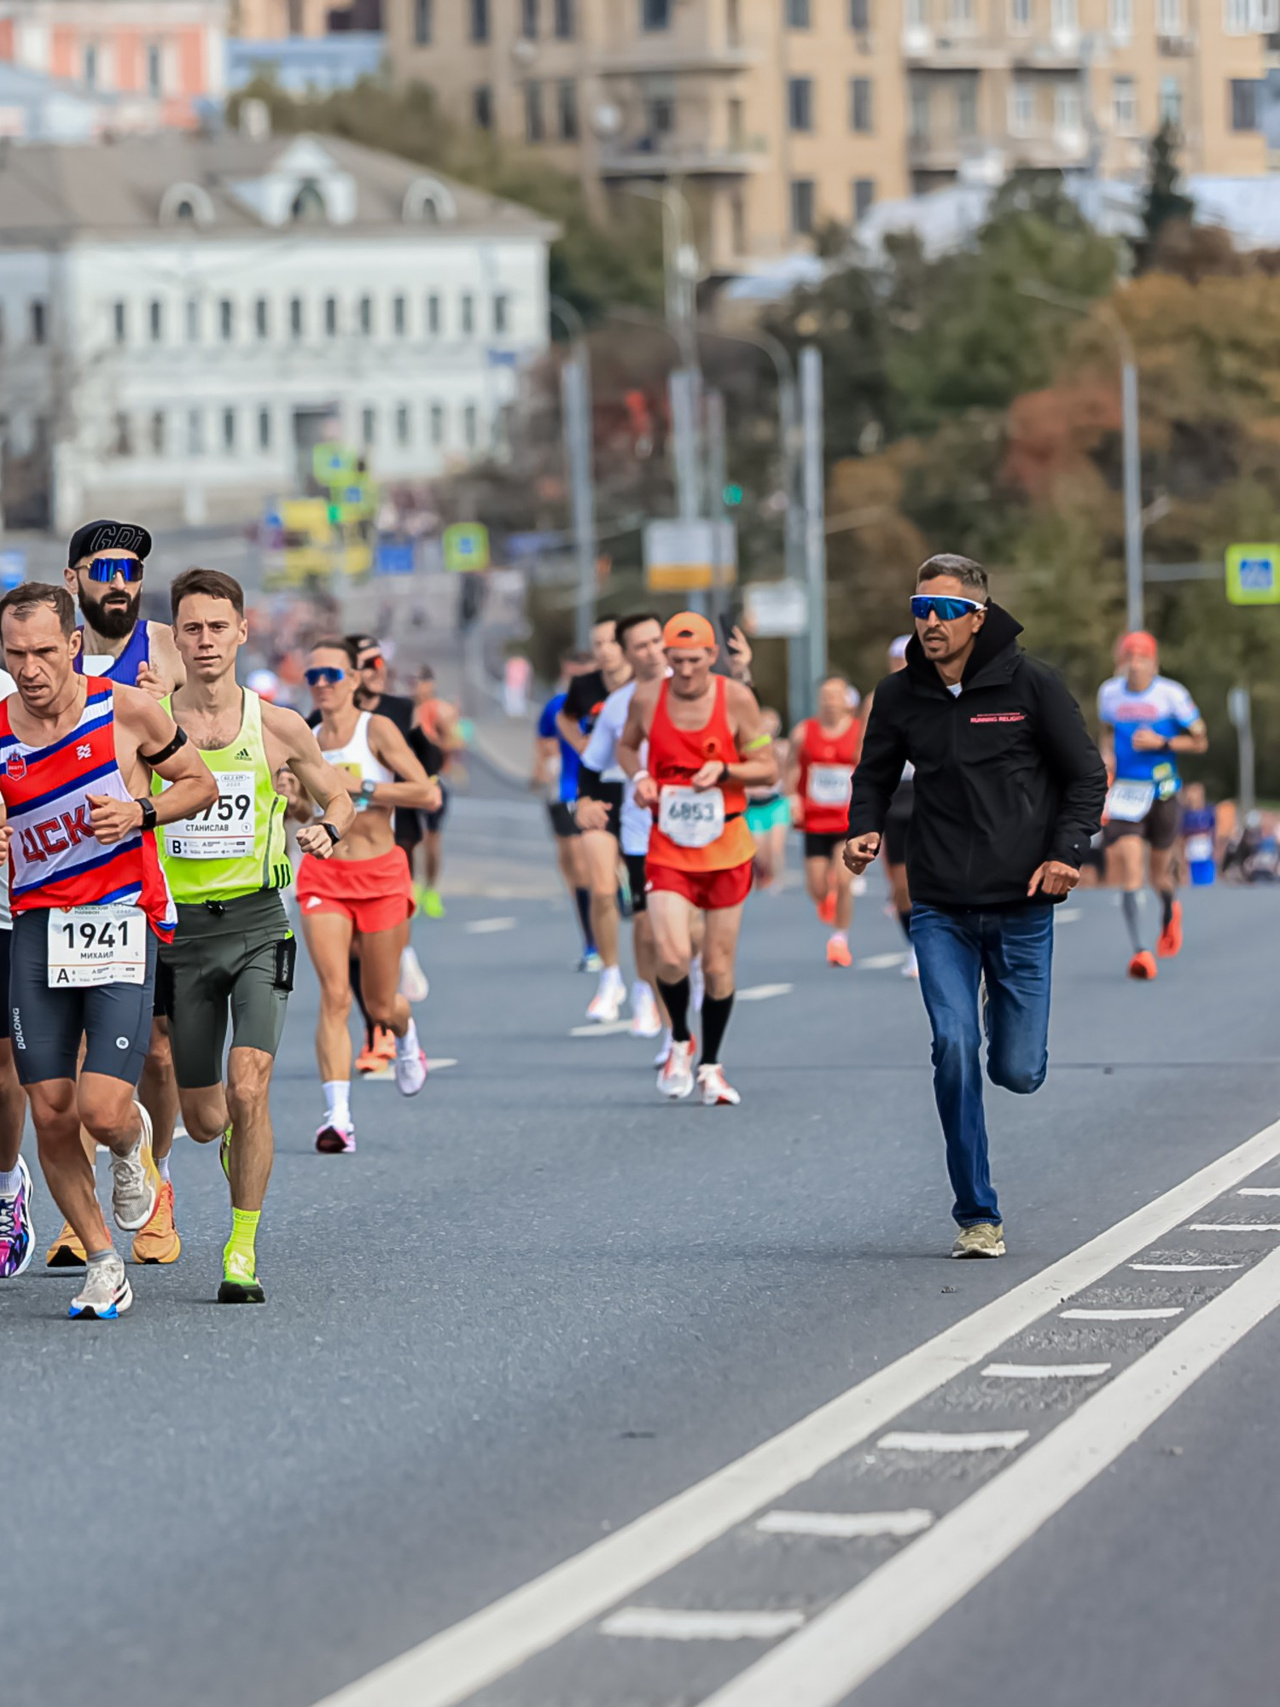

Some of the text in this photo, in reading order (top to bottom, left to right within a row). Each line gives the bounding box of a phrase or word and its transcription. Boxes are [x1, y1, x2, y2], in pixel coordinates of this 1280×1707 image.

[19, 794, 109, 863] ЦСК
[185, 824, 229, 832] СТАНИСЛАВ
[63, 920, 128, 949] 1941
[80, 951, 114, 959] МИХАИЛ
